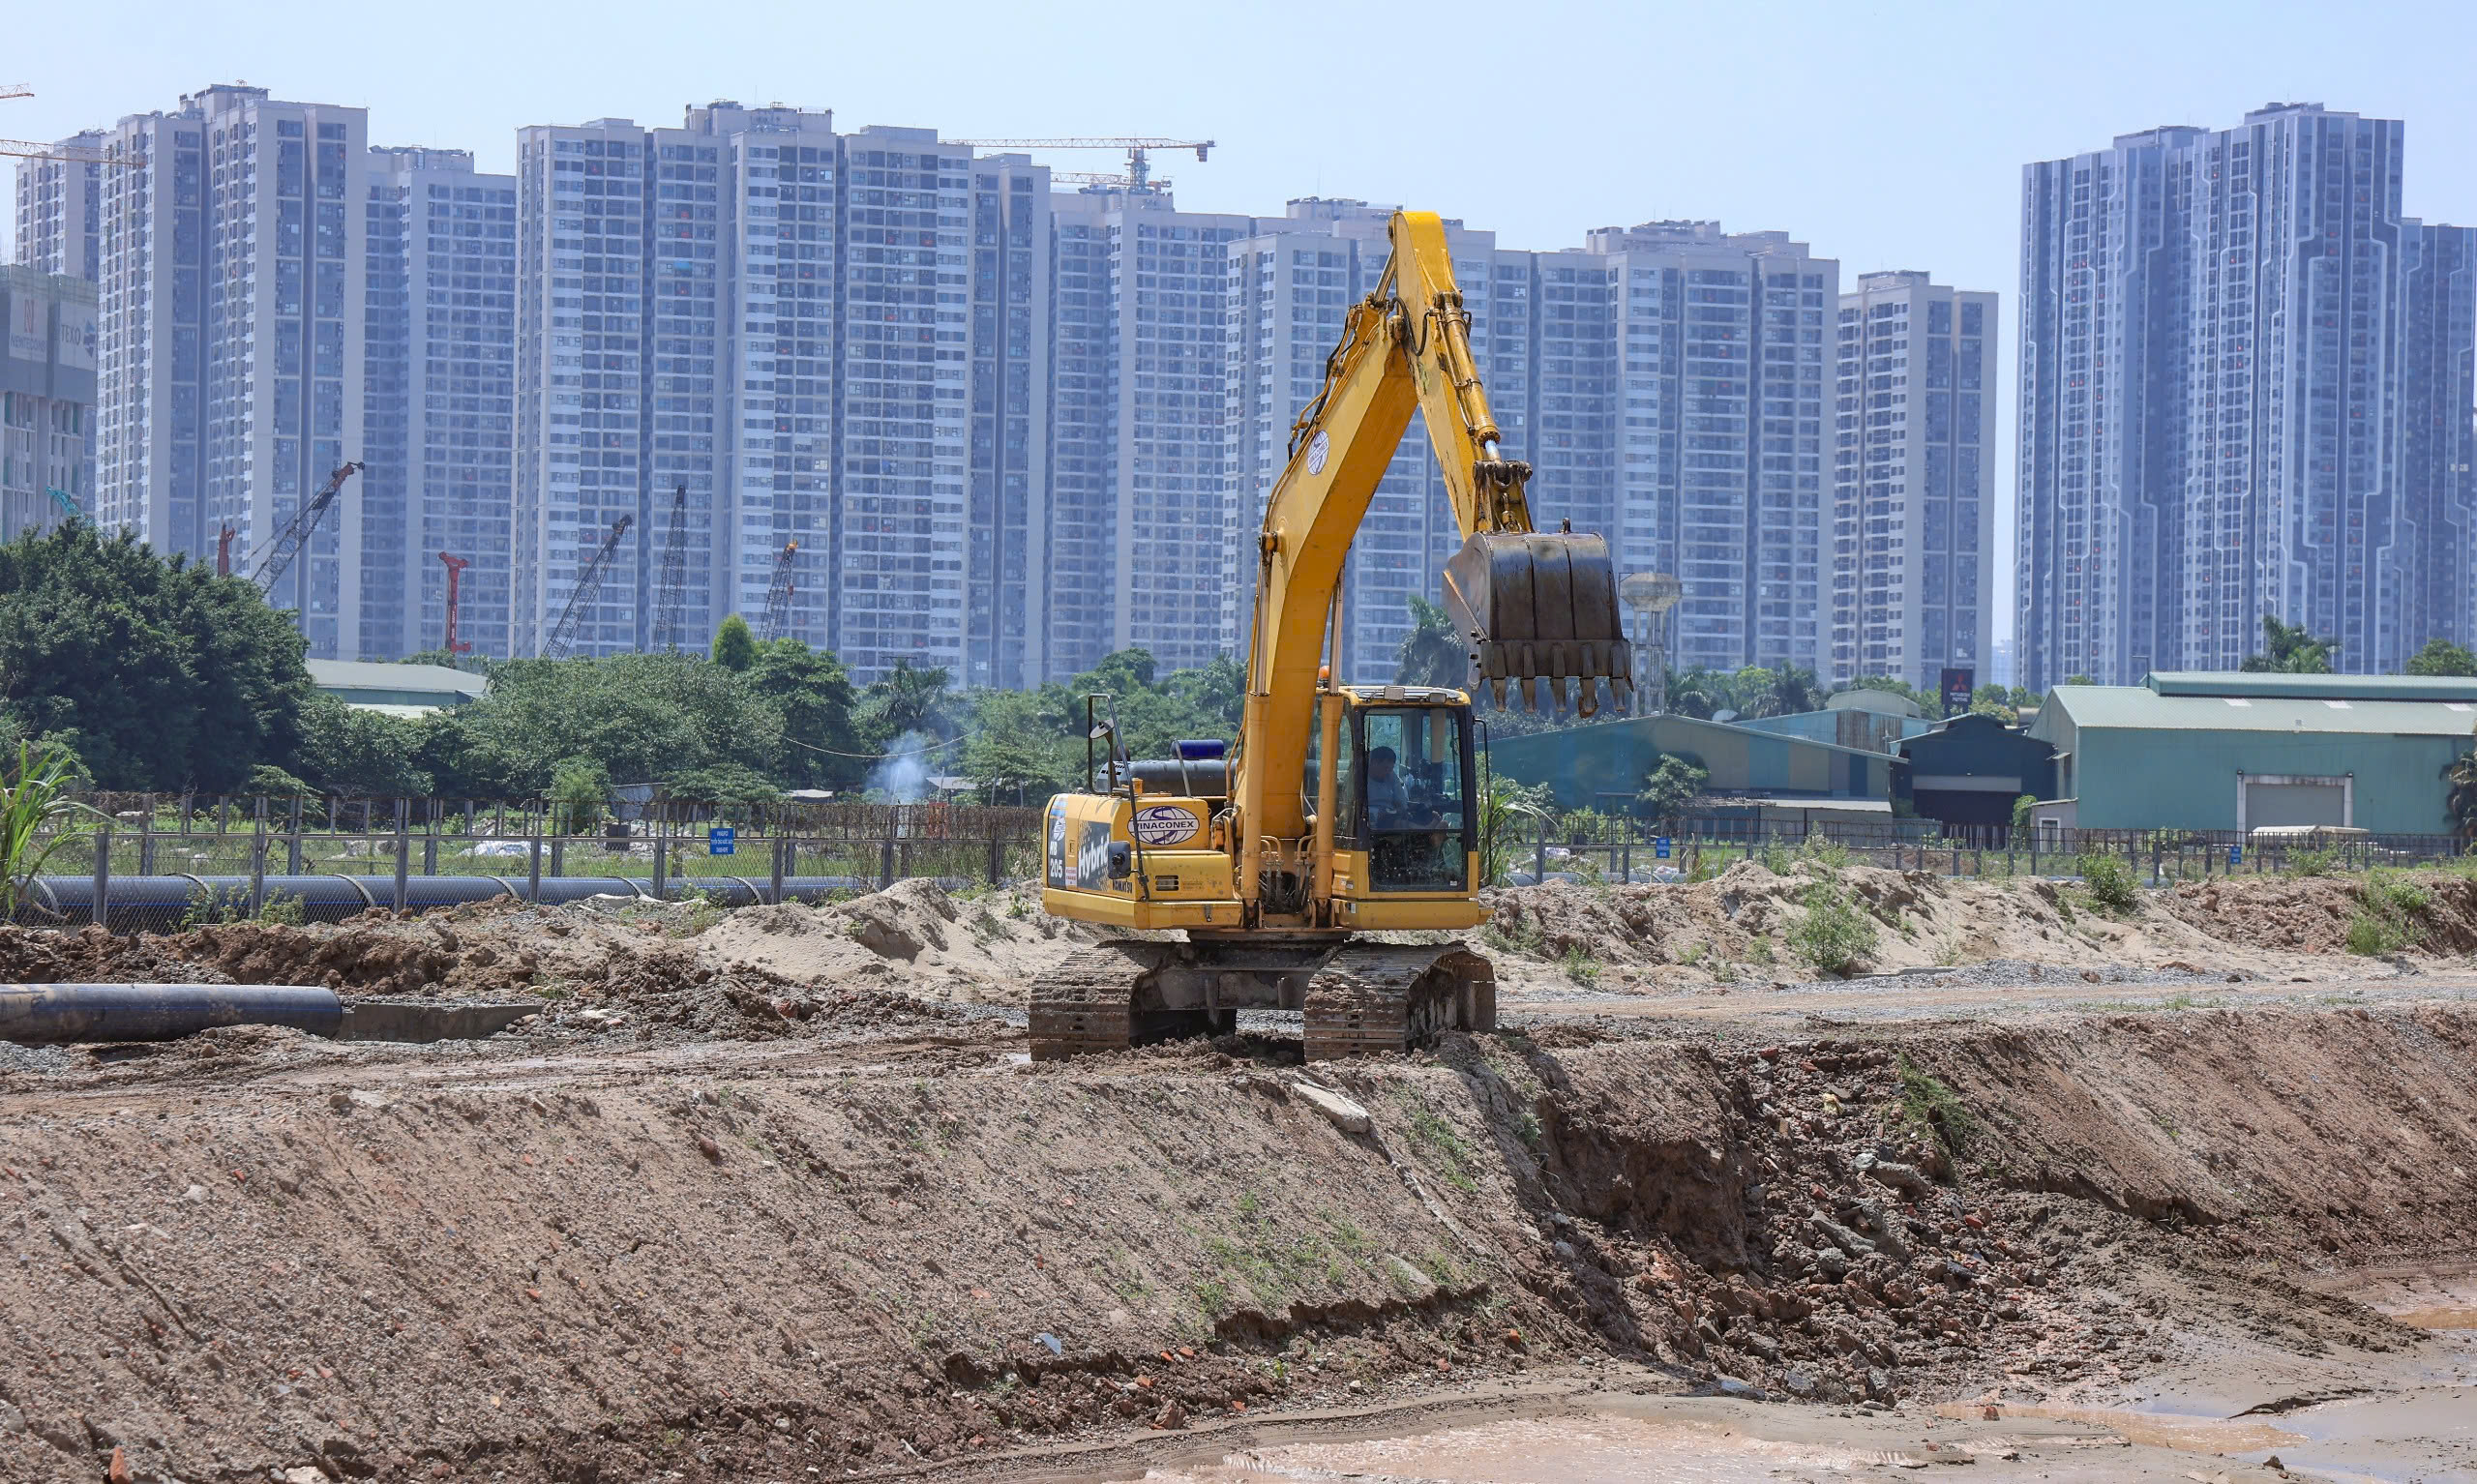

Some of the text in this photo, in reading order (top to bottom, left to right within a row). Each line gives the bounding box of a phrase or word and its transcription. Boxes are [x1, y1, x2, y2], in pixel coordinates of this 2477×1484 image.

[61, 324, 81, 346] TEXO
[1078, 833, 1110, 880] Hybrid
[1050, 858, 1063, 878] 205
